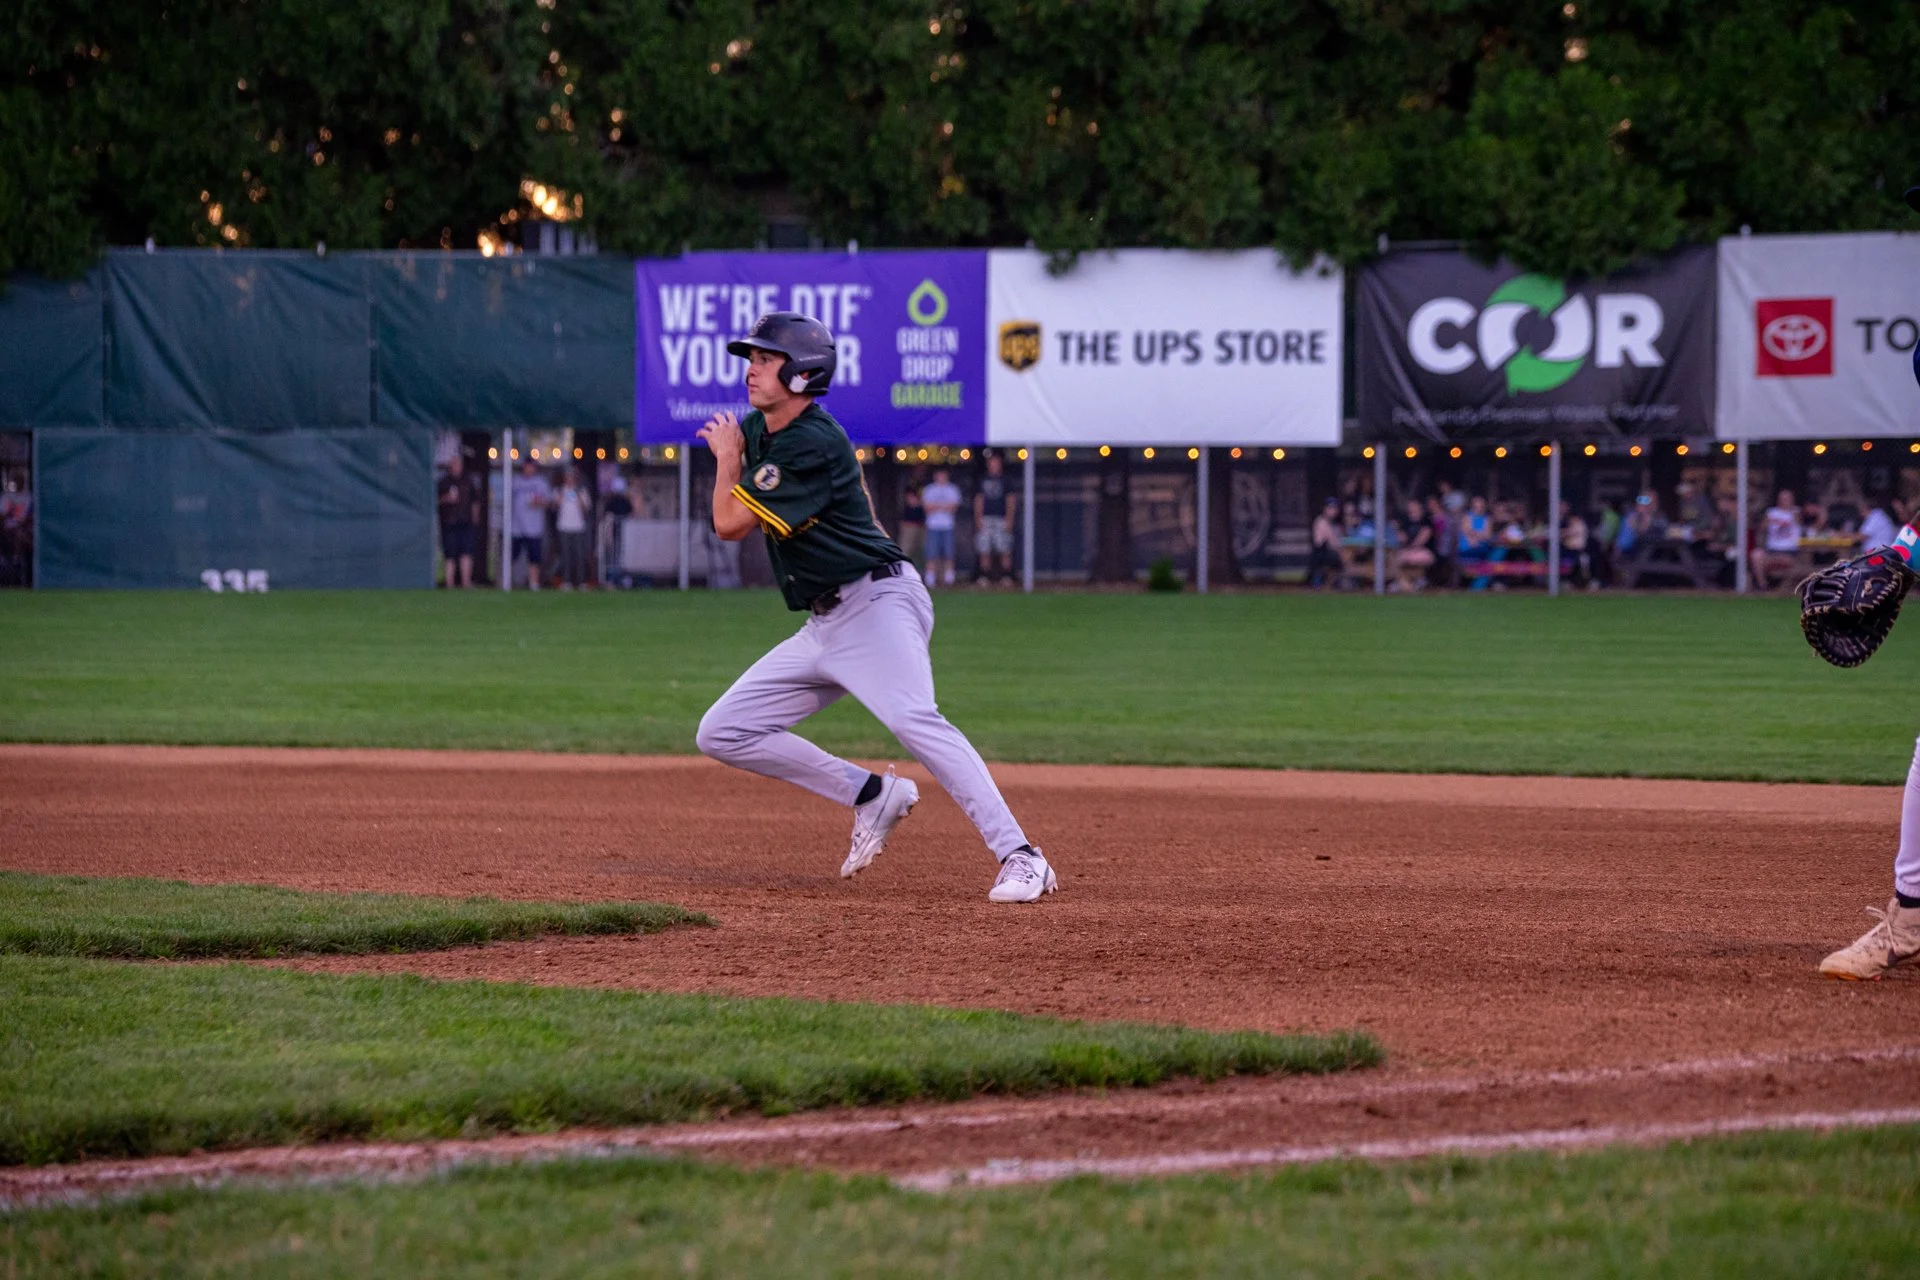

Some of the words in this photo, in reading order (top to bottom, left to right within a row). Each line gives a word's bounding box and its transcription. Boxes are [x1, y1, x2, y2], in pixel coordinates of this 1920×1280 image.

[659, 284, 780, 332] WE'RE
[1056, 329, 1120, 366] THE
[1133, 329, 1203, 366] UPS
[1214, 329, 1328, 366] STORE
[1407, 278, 1665, 390] COR
